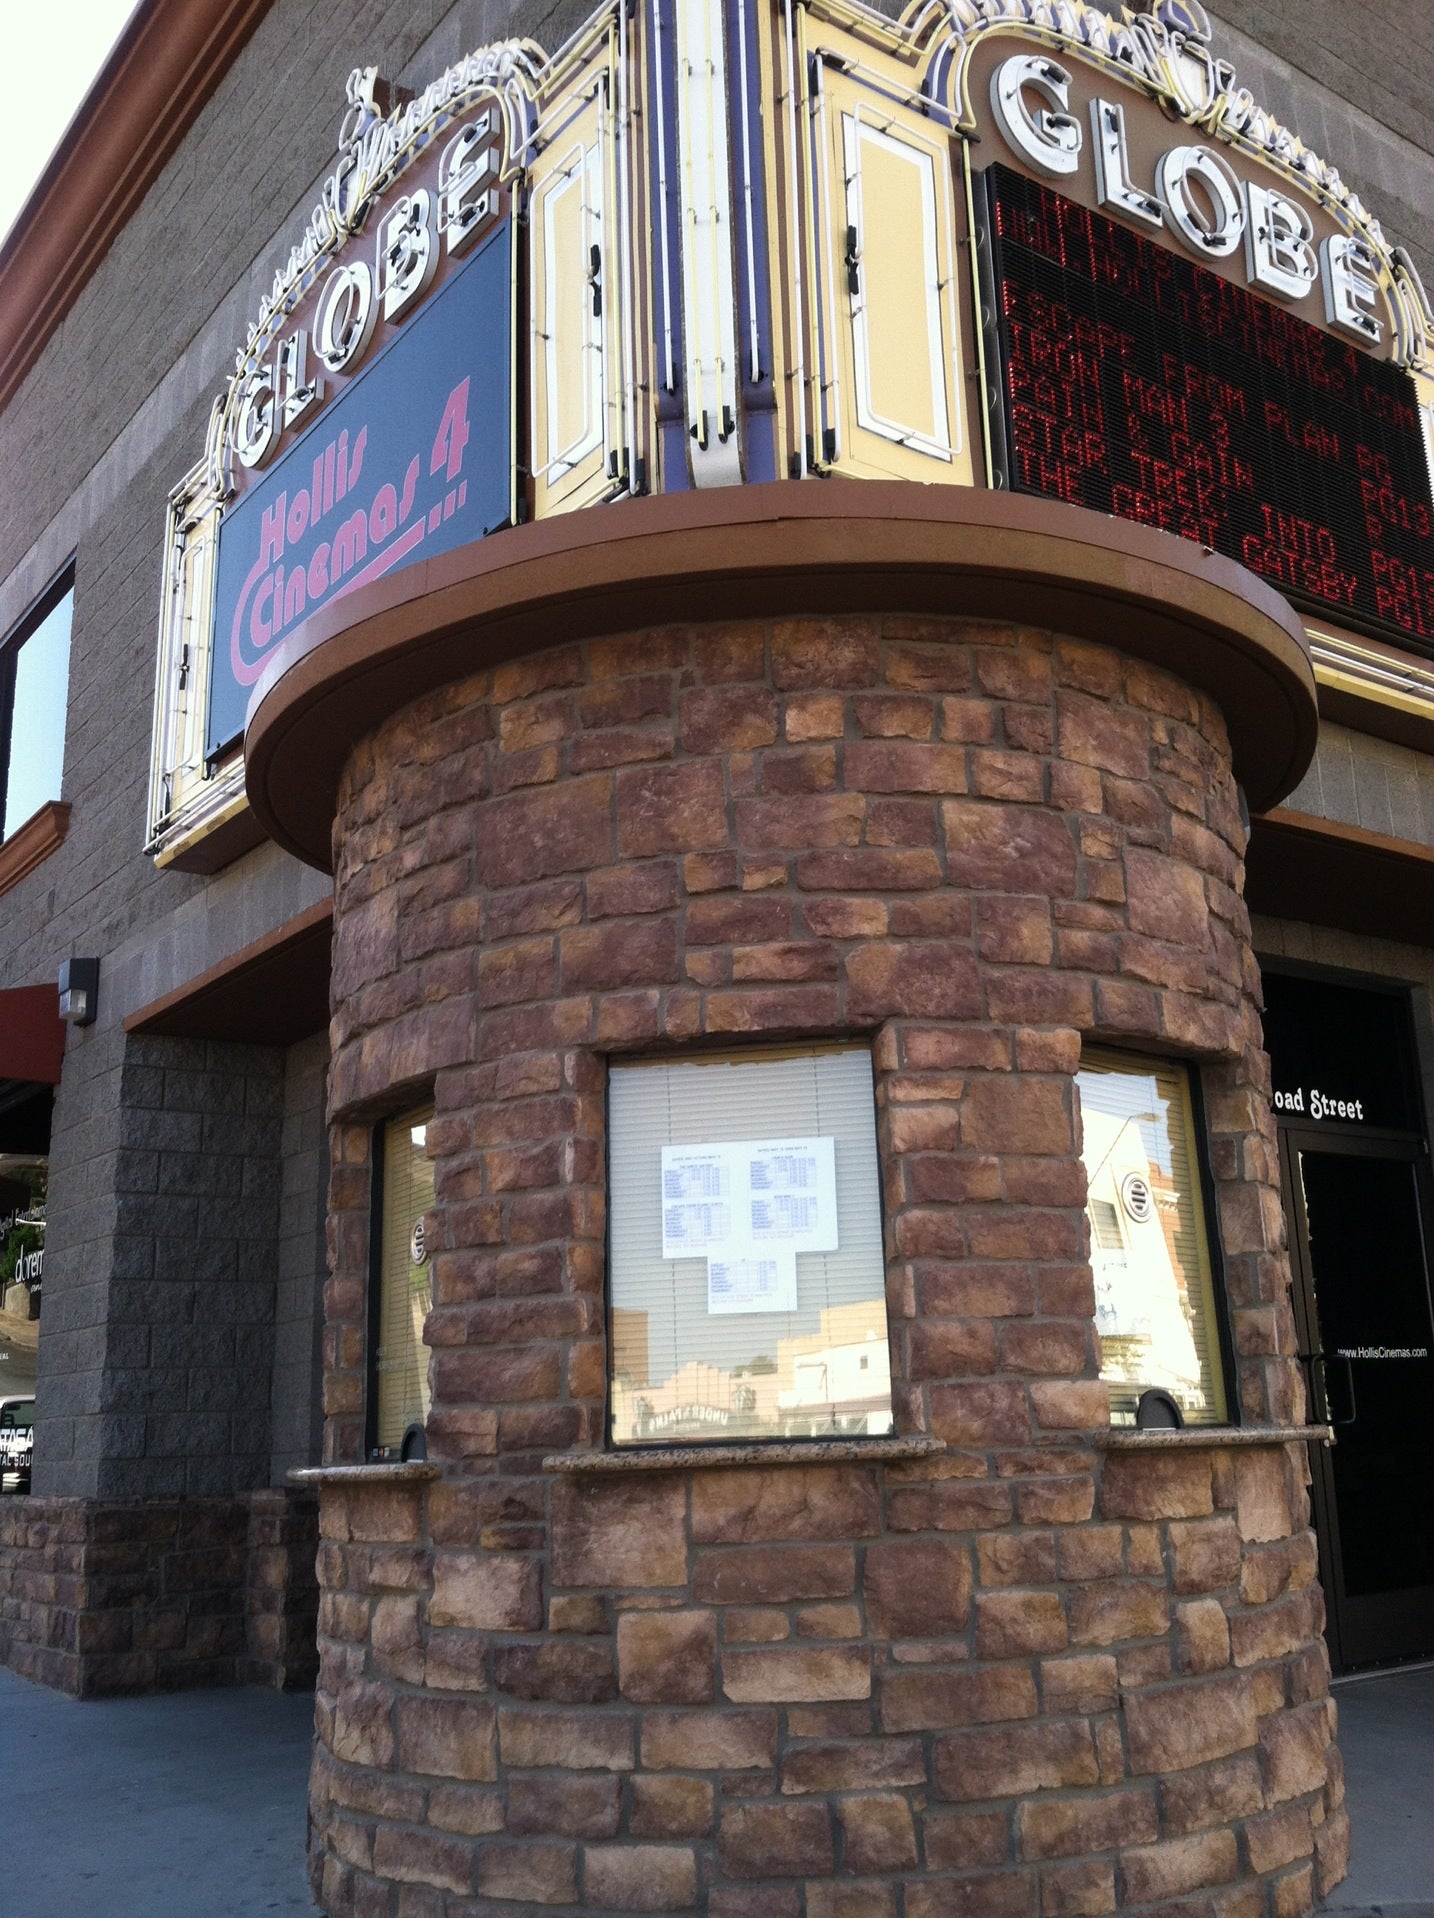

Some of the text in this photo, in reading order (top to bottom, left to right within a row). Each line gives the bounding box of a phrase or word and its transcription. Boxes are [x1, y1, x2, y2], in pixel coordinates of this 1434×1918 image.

[232, 107, 498, 469] GLOBE
[990, 55, 1384, 348] GLOBE
[1002, 278, 1393, 489] ESCAPE FROM PLAN PG
[1007, 357, 1104, 435] PAIN
[1126, 409, 1149, 451] &
[1170, 427, 1256, 498] GAIN
[1009, 319, 1432, 540] IRON MAN 3 PG13
[1010, 398, 1108, 478] STAR
[1129, 448, 1230, 526] TREK:
[1259, 502, 1337, 566] INTO
[250, 375, 471, 648] Cinemas 4
[259, 425, 368, 566] Hollis
[1015, 439, 1434, 642] THE GREAT GATSBY PG1
[1311, 1089, 1363, 1120] Street
[1338, 1347, 1426, 1358] www.HollisCinemas.com
